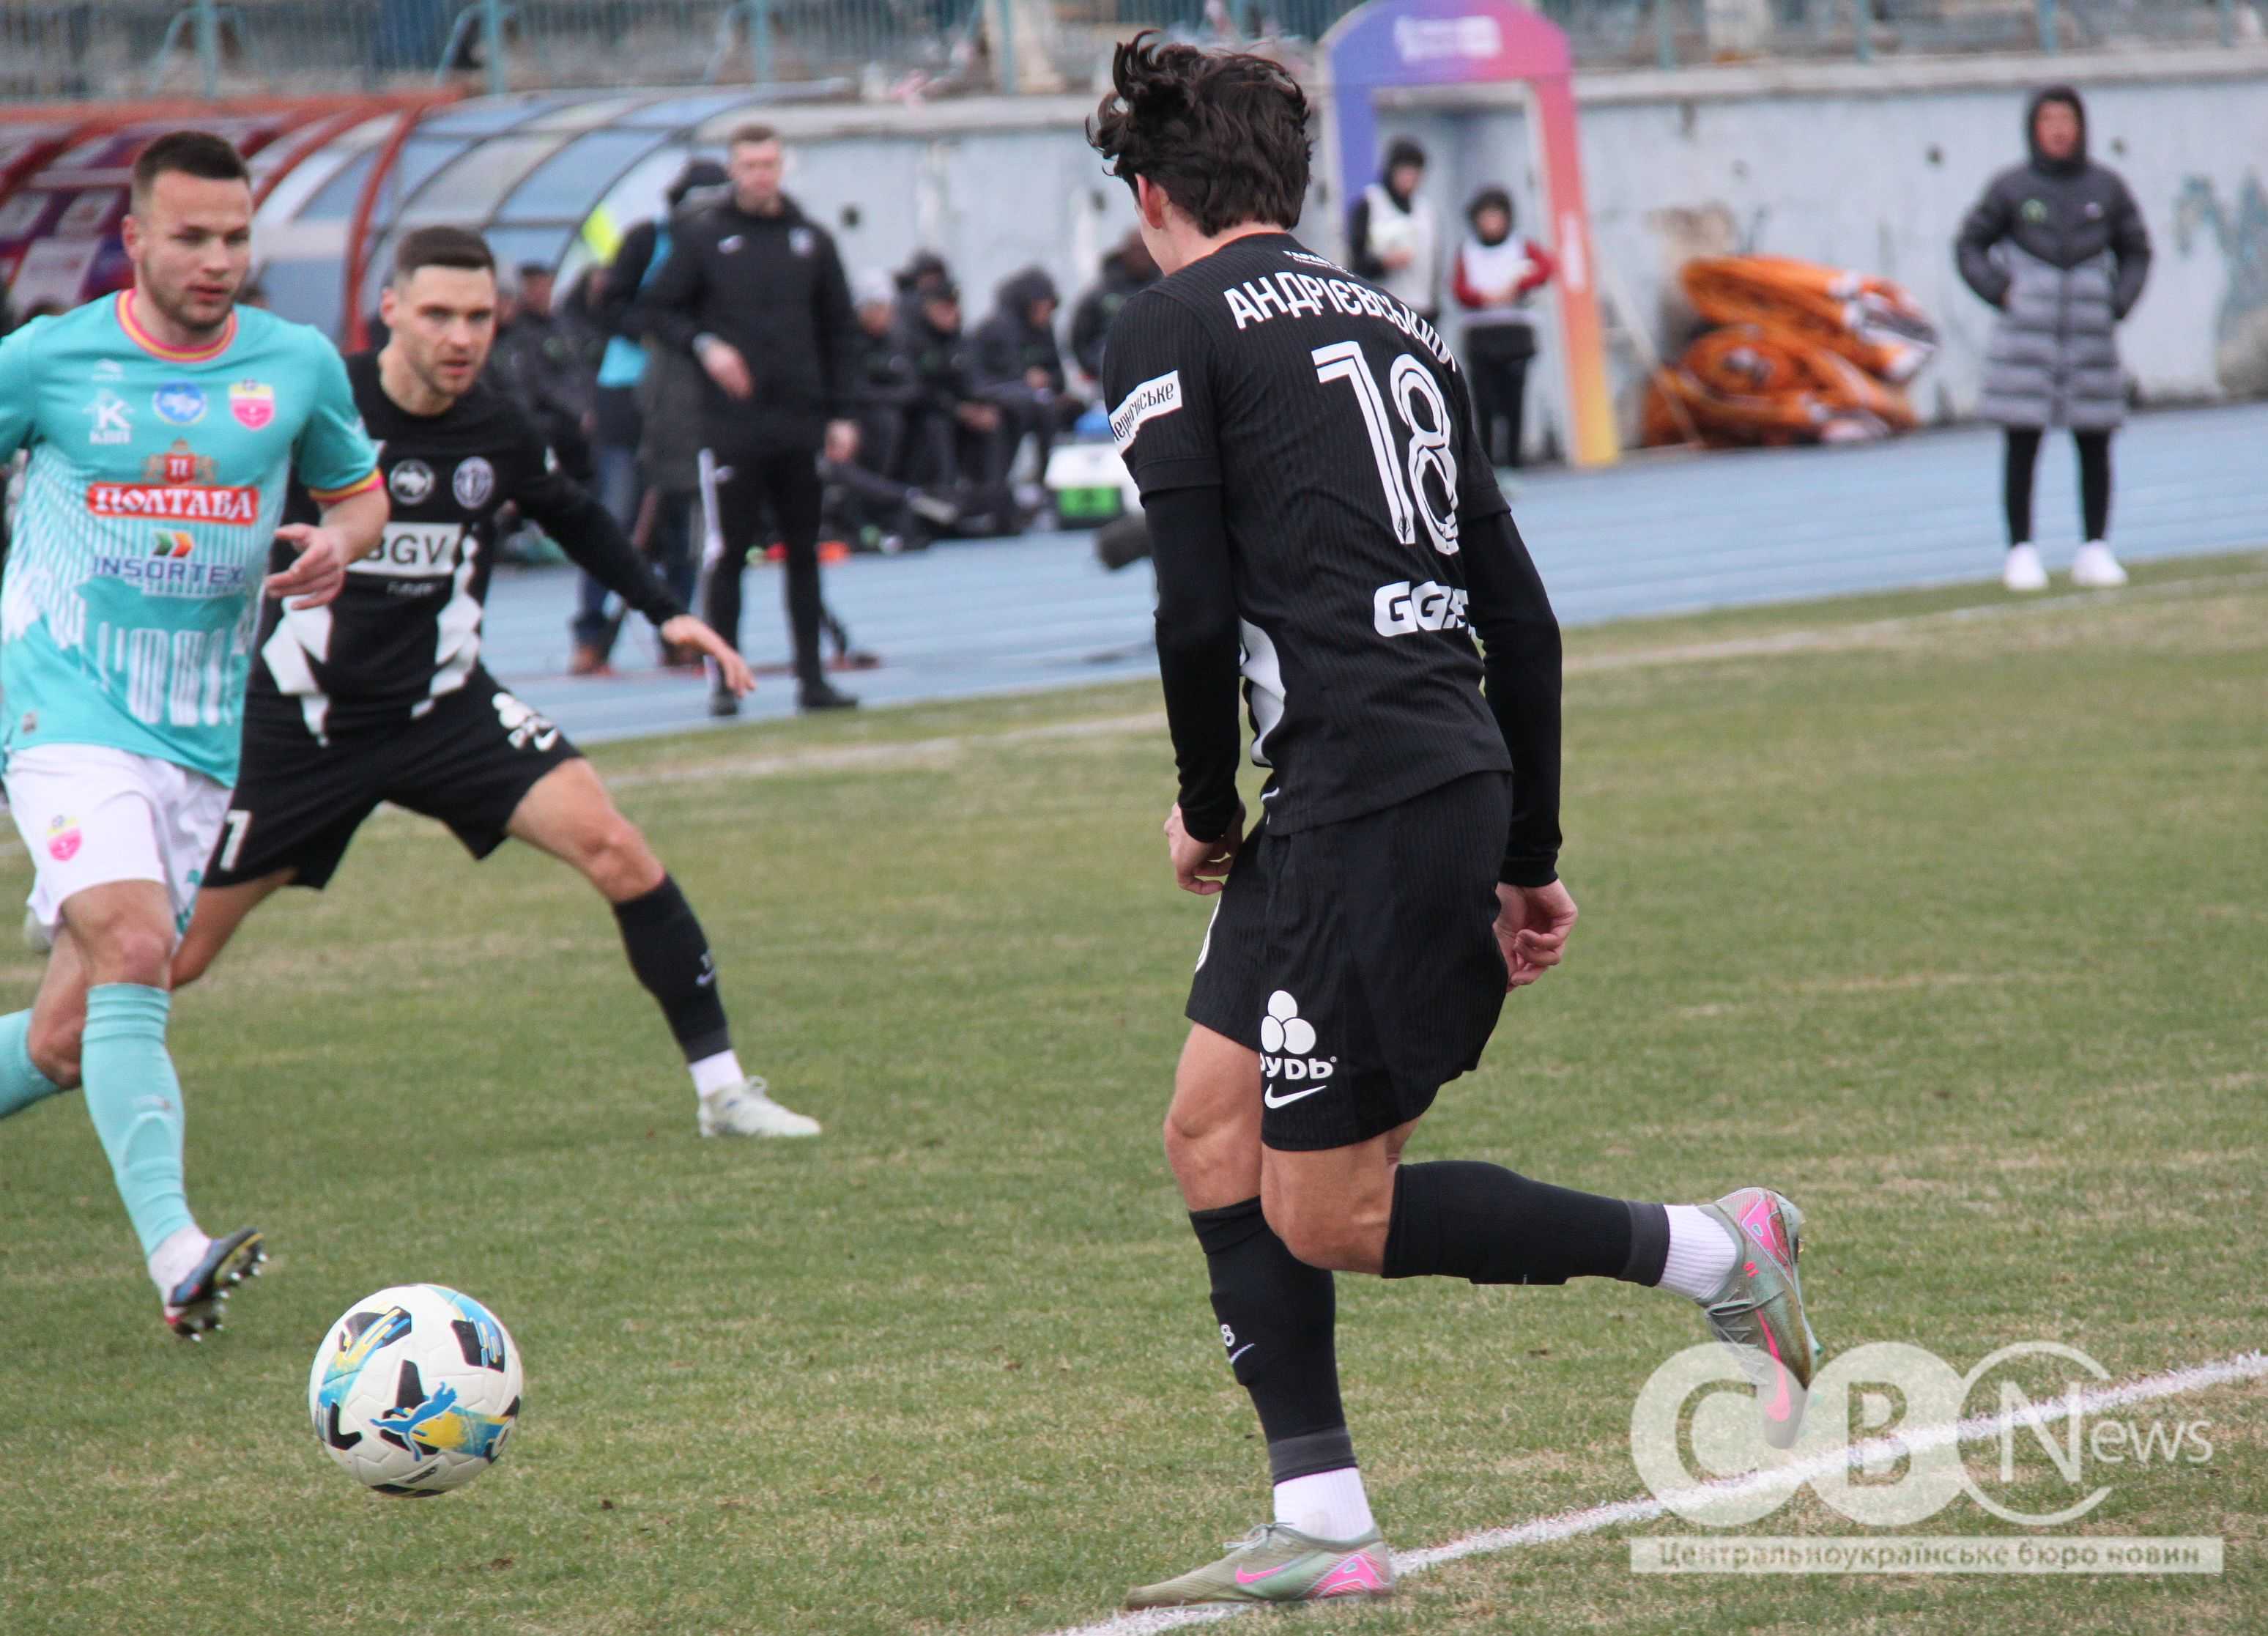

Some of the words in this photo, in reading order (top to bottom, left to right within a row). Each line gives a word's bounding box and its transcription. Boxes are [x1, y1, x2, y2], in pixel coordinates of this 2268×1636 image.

[1312, 341, 1459, 555] 18
[95, 486, 253, 519] ПОЛТАВА
[93, 556, 246, 584] INSORTEX
